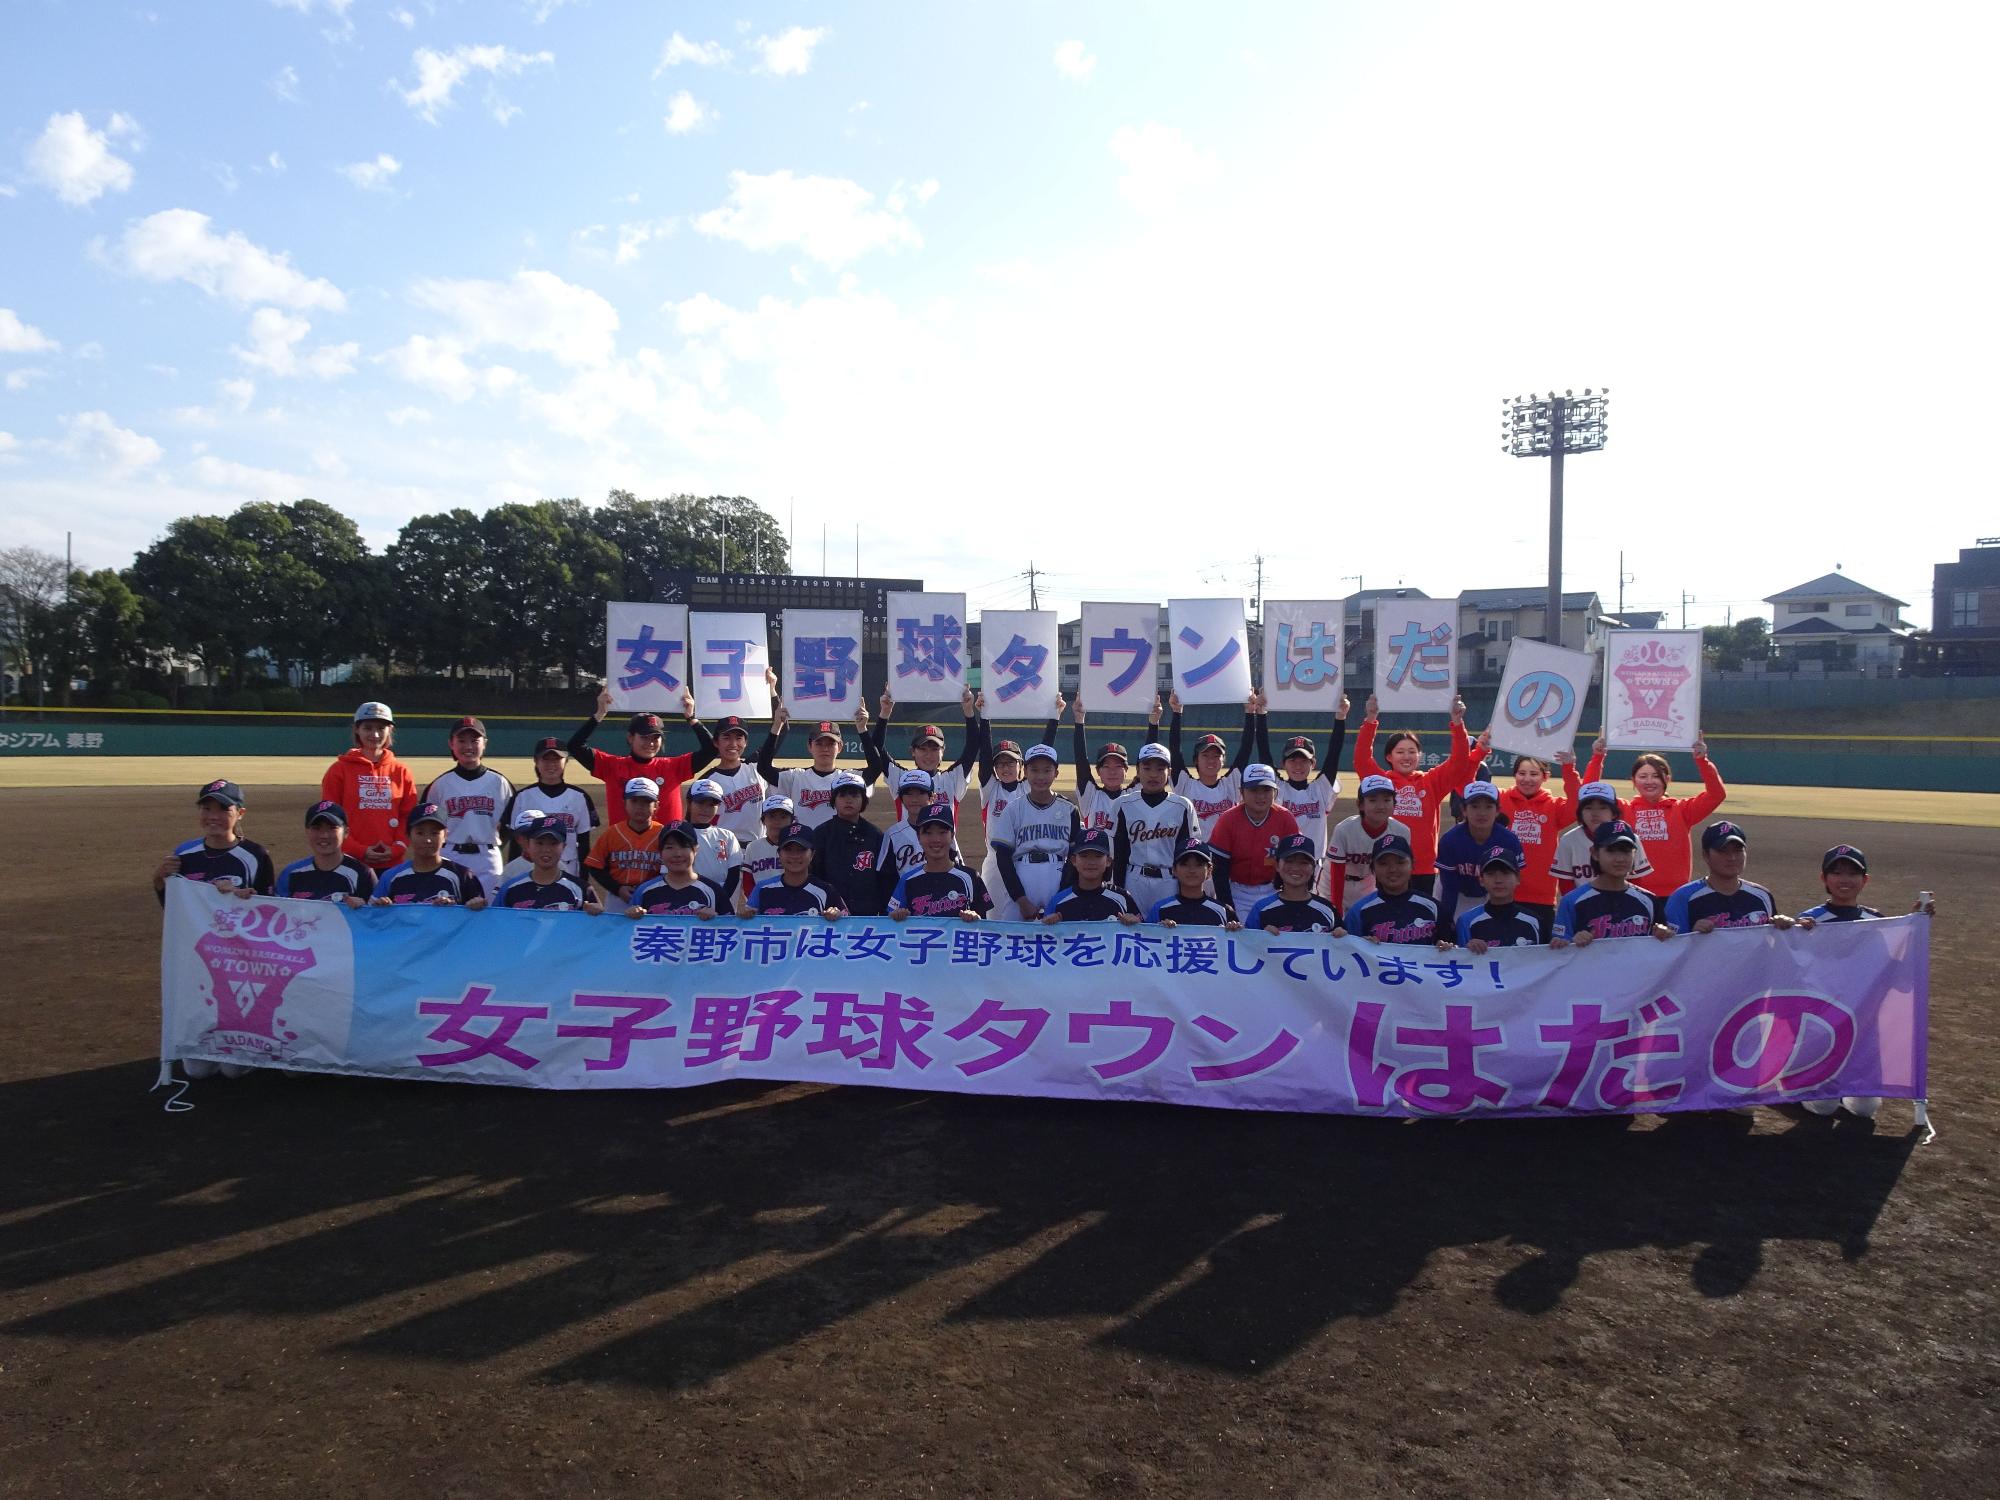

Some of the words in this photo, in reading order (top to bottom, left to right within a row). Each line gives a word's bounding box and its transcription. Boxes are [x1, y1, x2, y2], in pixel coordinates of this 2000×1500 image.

[696, 576, 719, 585] TEAM
[616, 625, 683, 691] 女
[701, 640, 765, 702] 子
[793, 637, 859, 702] 野
[895, 614, 962, 681] 球
[991, 634, 1049, 702] タ
[1090, 628, 1153, 696] ウ
[1179, 626, 1241, 688] ン
[1275, 621, 1339, 686] は
[1387, 621, 1452, 687] だ
[1506, 671, 1576, 733] の
[66, 732, 104, 748] 秦野
[1016, 823, 1070, 846] SKYHAWKS
[1129, 820, 1180, 844] Peckers
[223, 958, 280, 977] TOWN
[632, 924, 1506, 990] 秦野市は女子野球を応援しています！
